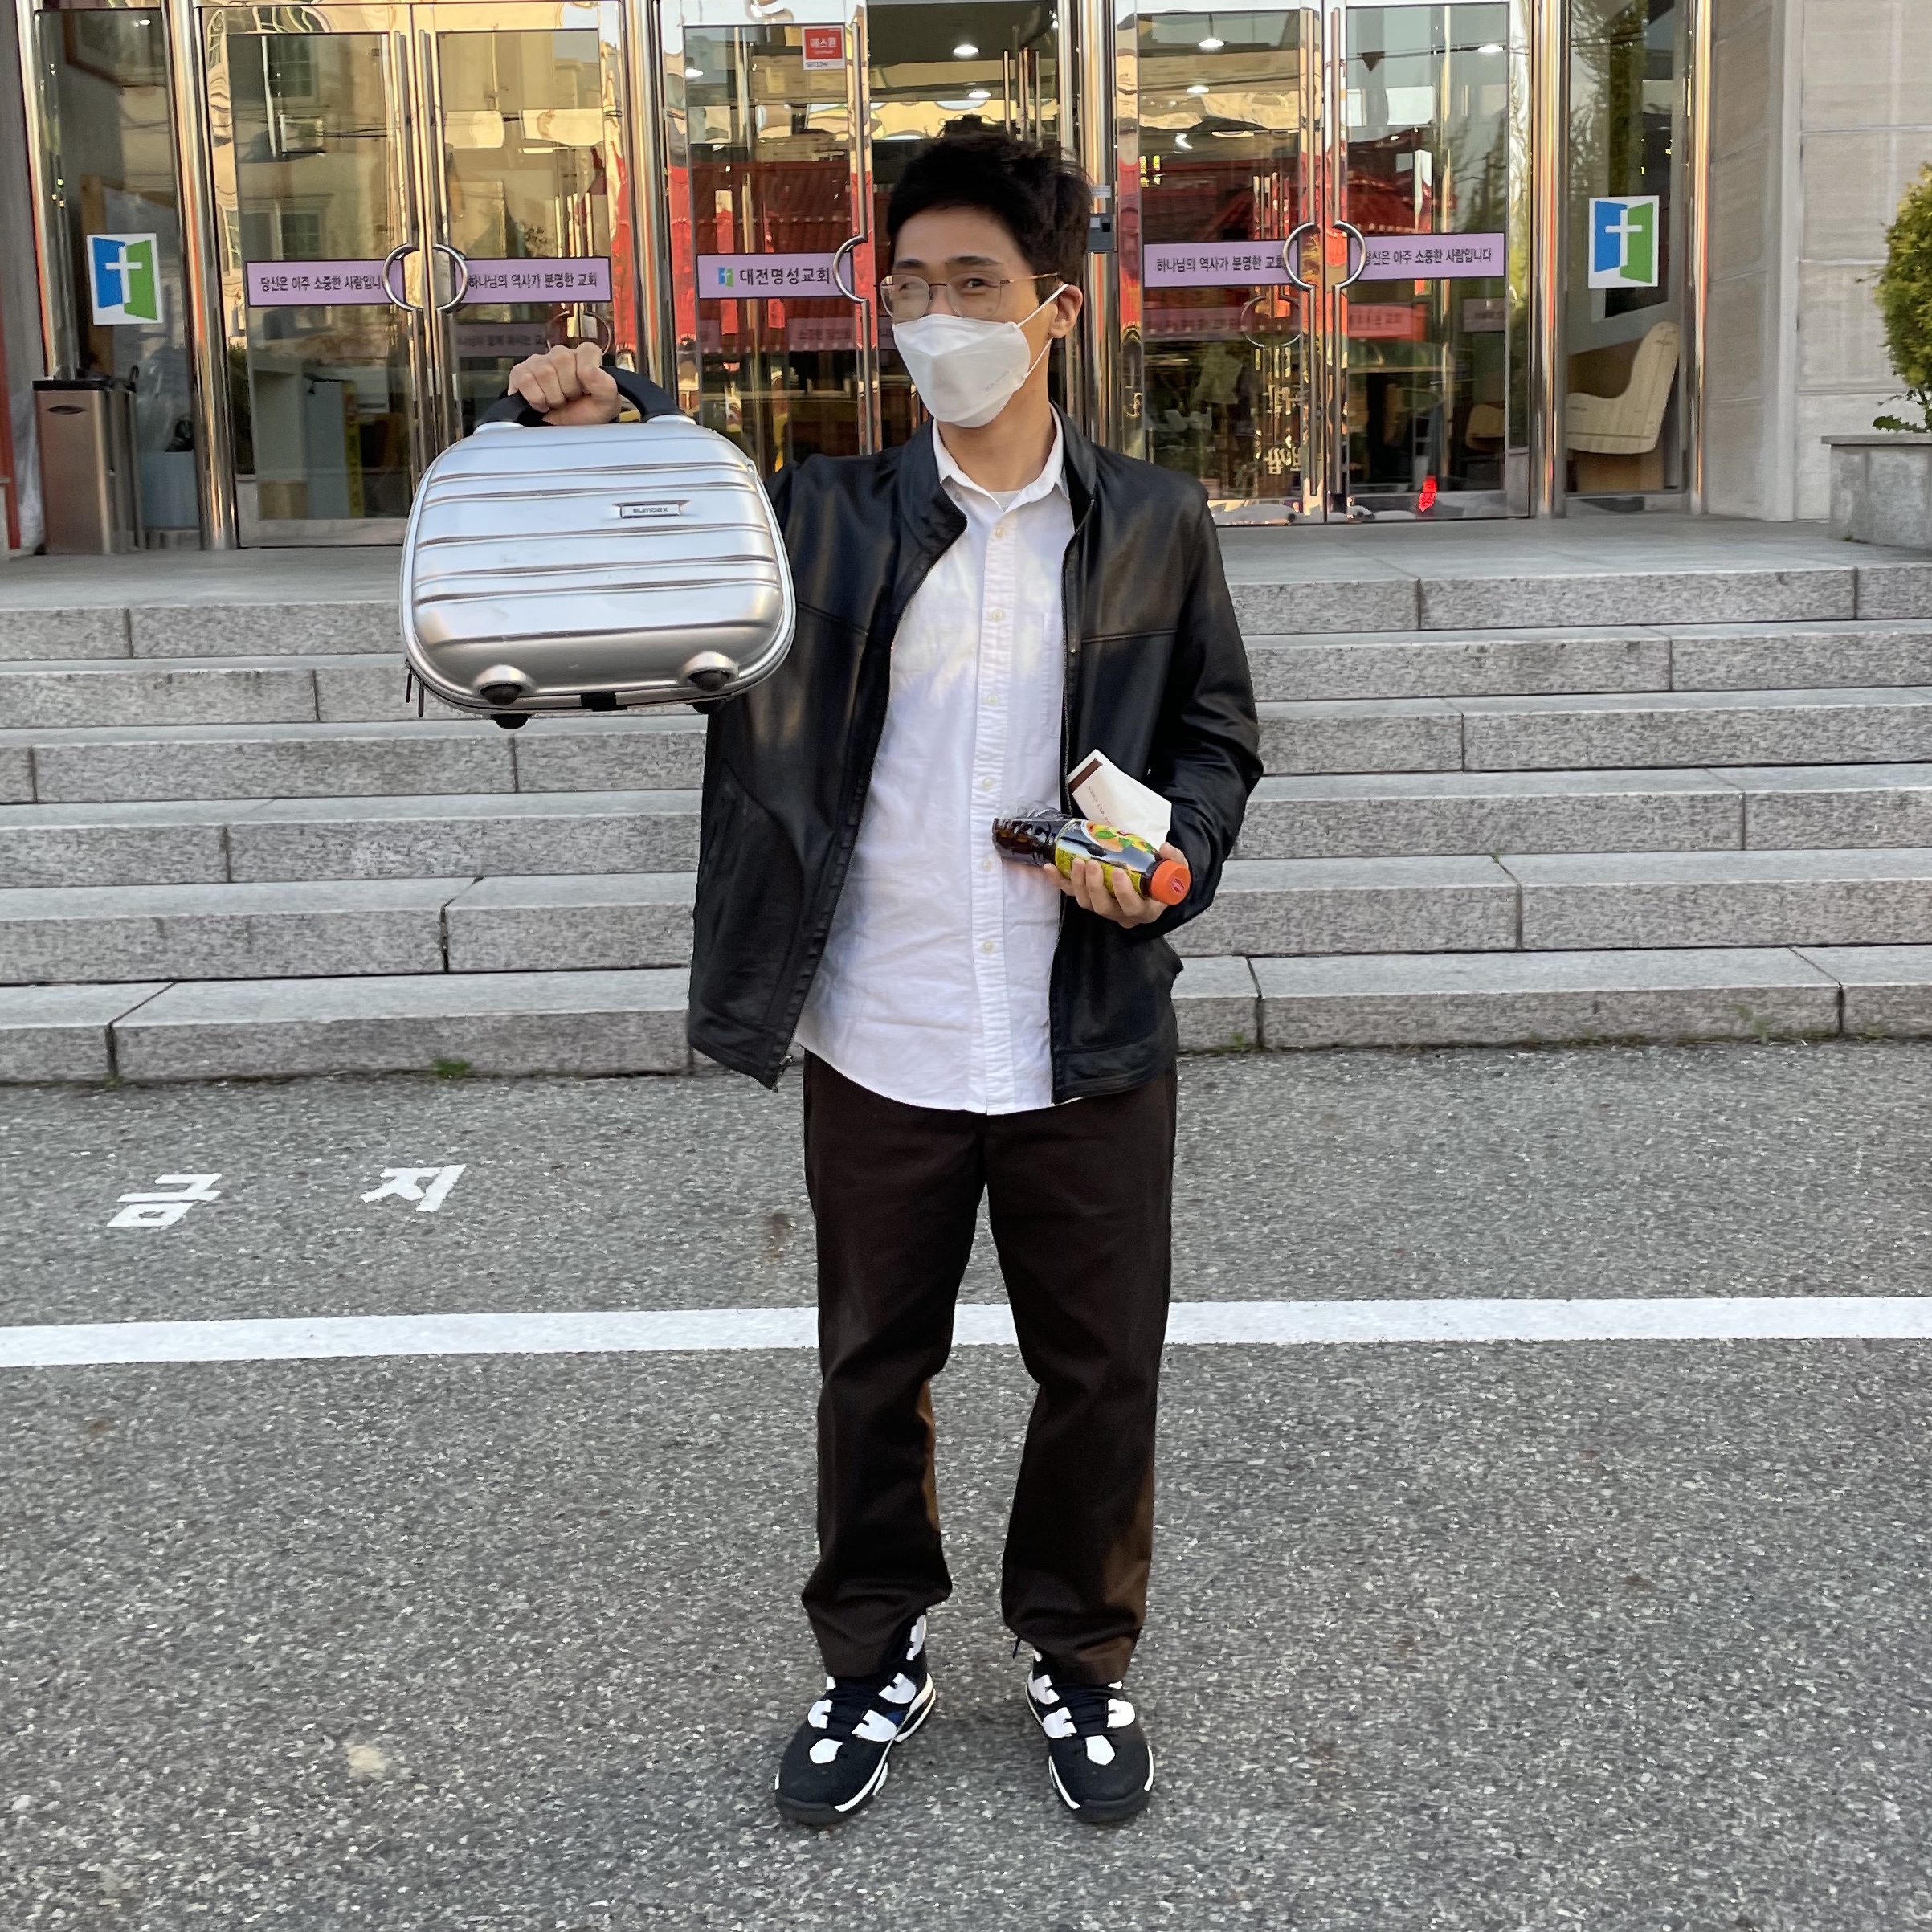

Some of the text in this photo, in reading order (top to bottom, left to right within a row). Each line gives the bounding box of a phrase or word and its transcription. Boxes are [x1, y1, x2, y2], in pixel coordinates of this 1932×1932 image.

[1157, 257, 1196, 273] 하나님의
[1199, 256, 1229, 272] 역사가
[1232, 255, 1262, 271] 분명한
[1393, 250, 1412, 265] 아주
[1415, 248, 1443, 264] 소중한
[1446, 247, 1492, 263] 사람입니다
[260, 274, 384, 292] 당신은 아주 소중한 사람입니
[468, 272, 598, 290] 하나님의 역사가 분명한 교회
[739, 267, 830, 286] 대전명성교회
